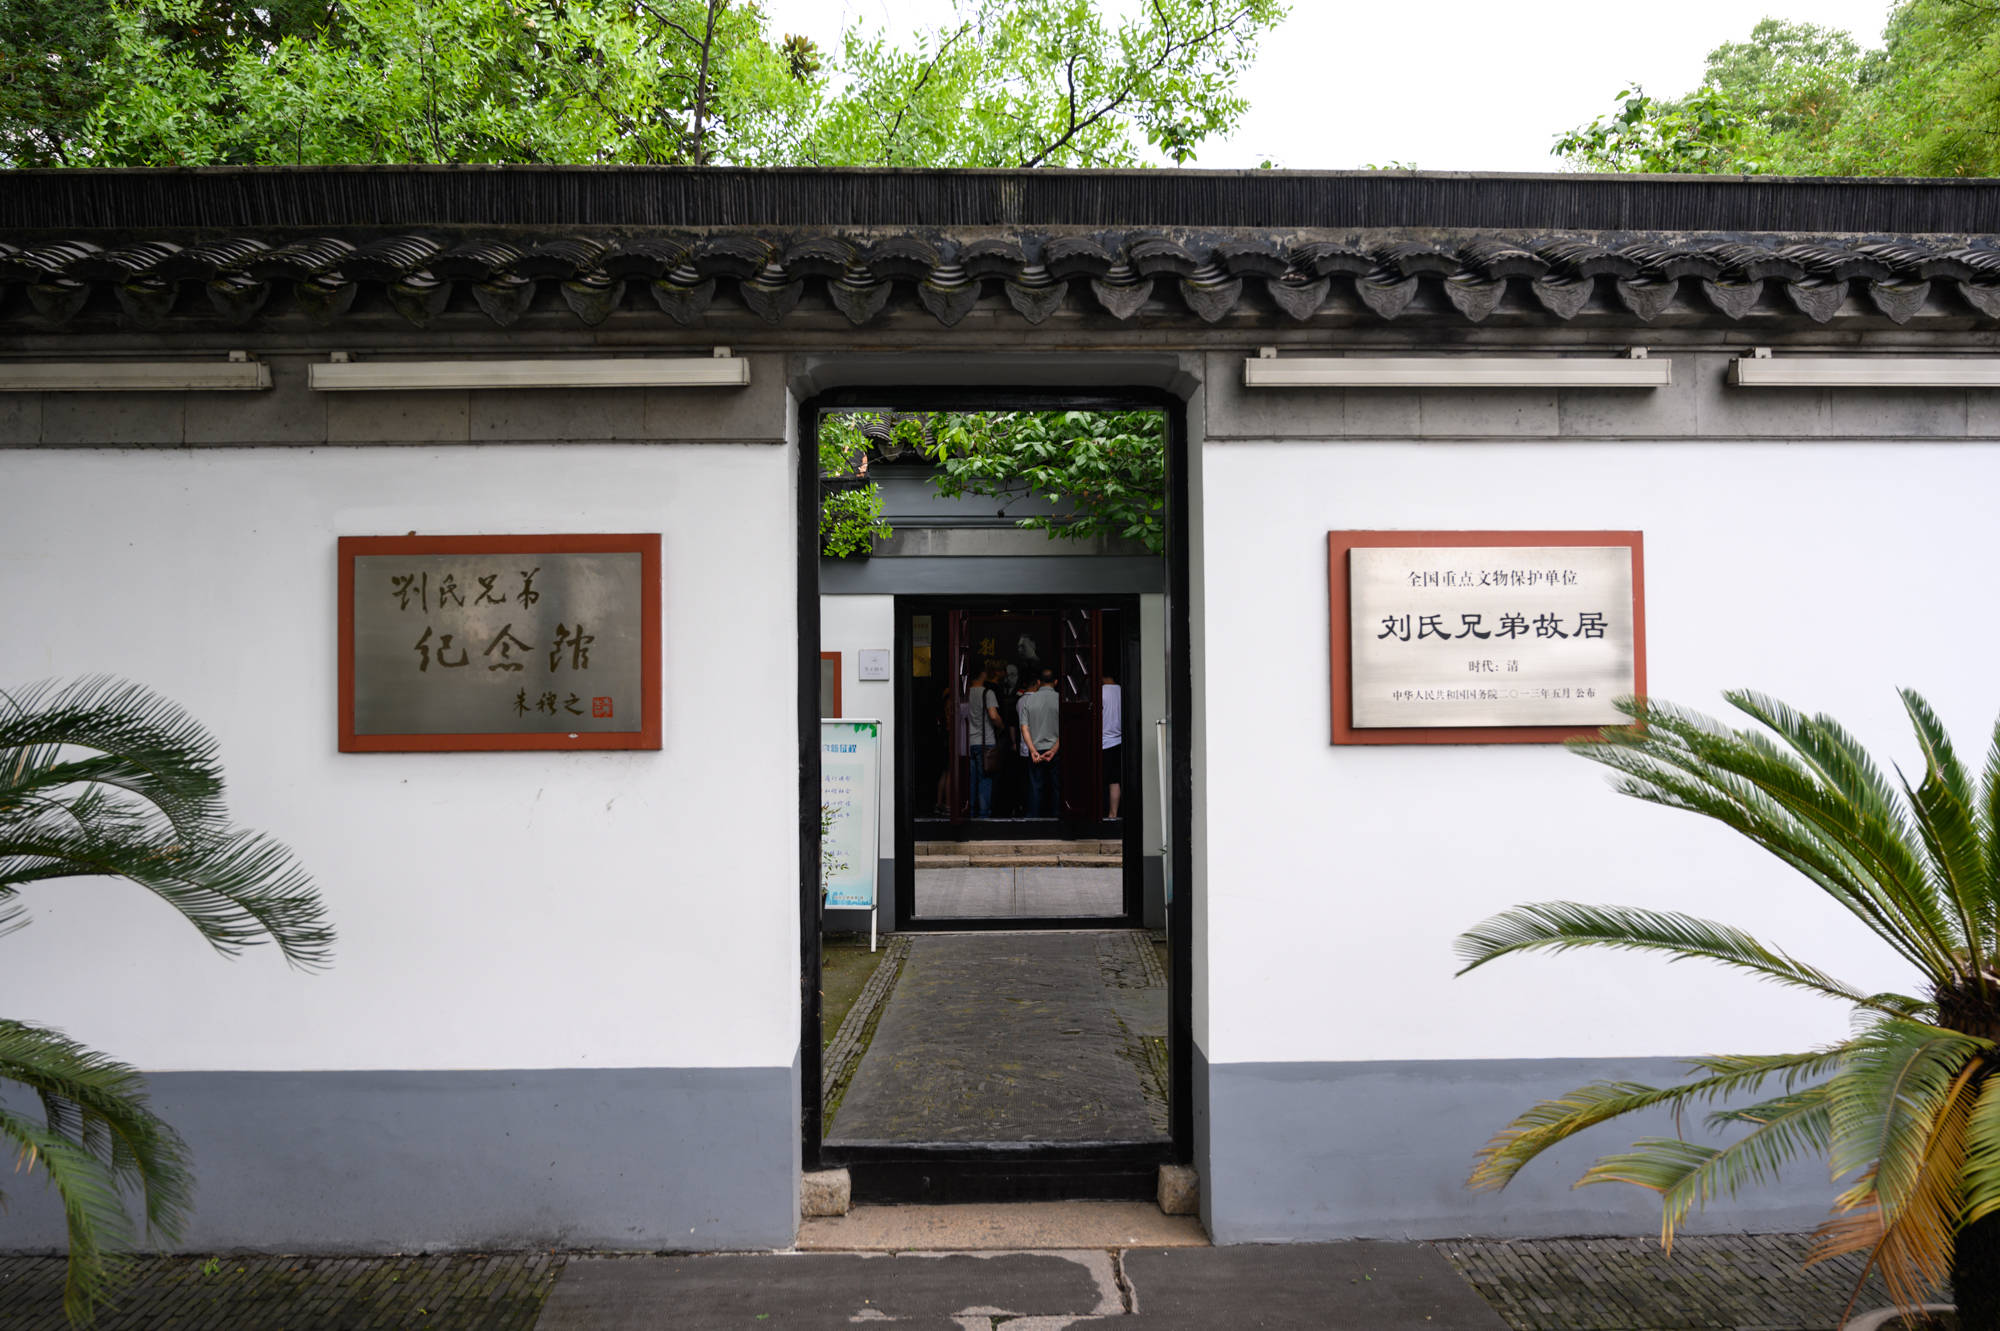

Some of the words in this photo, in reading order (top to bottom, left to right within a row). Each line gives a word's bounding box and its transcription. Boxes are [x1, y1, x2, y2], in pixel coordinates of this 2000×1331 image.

[1408, 570, 1578, 587] 全国重点文物保护单位
[1377, 612, 1609, 642] 刘氏兄弟故居
